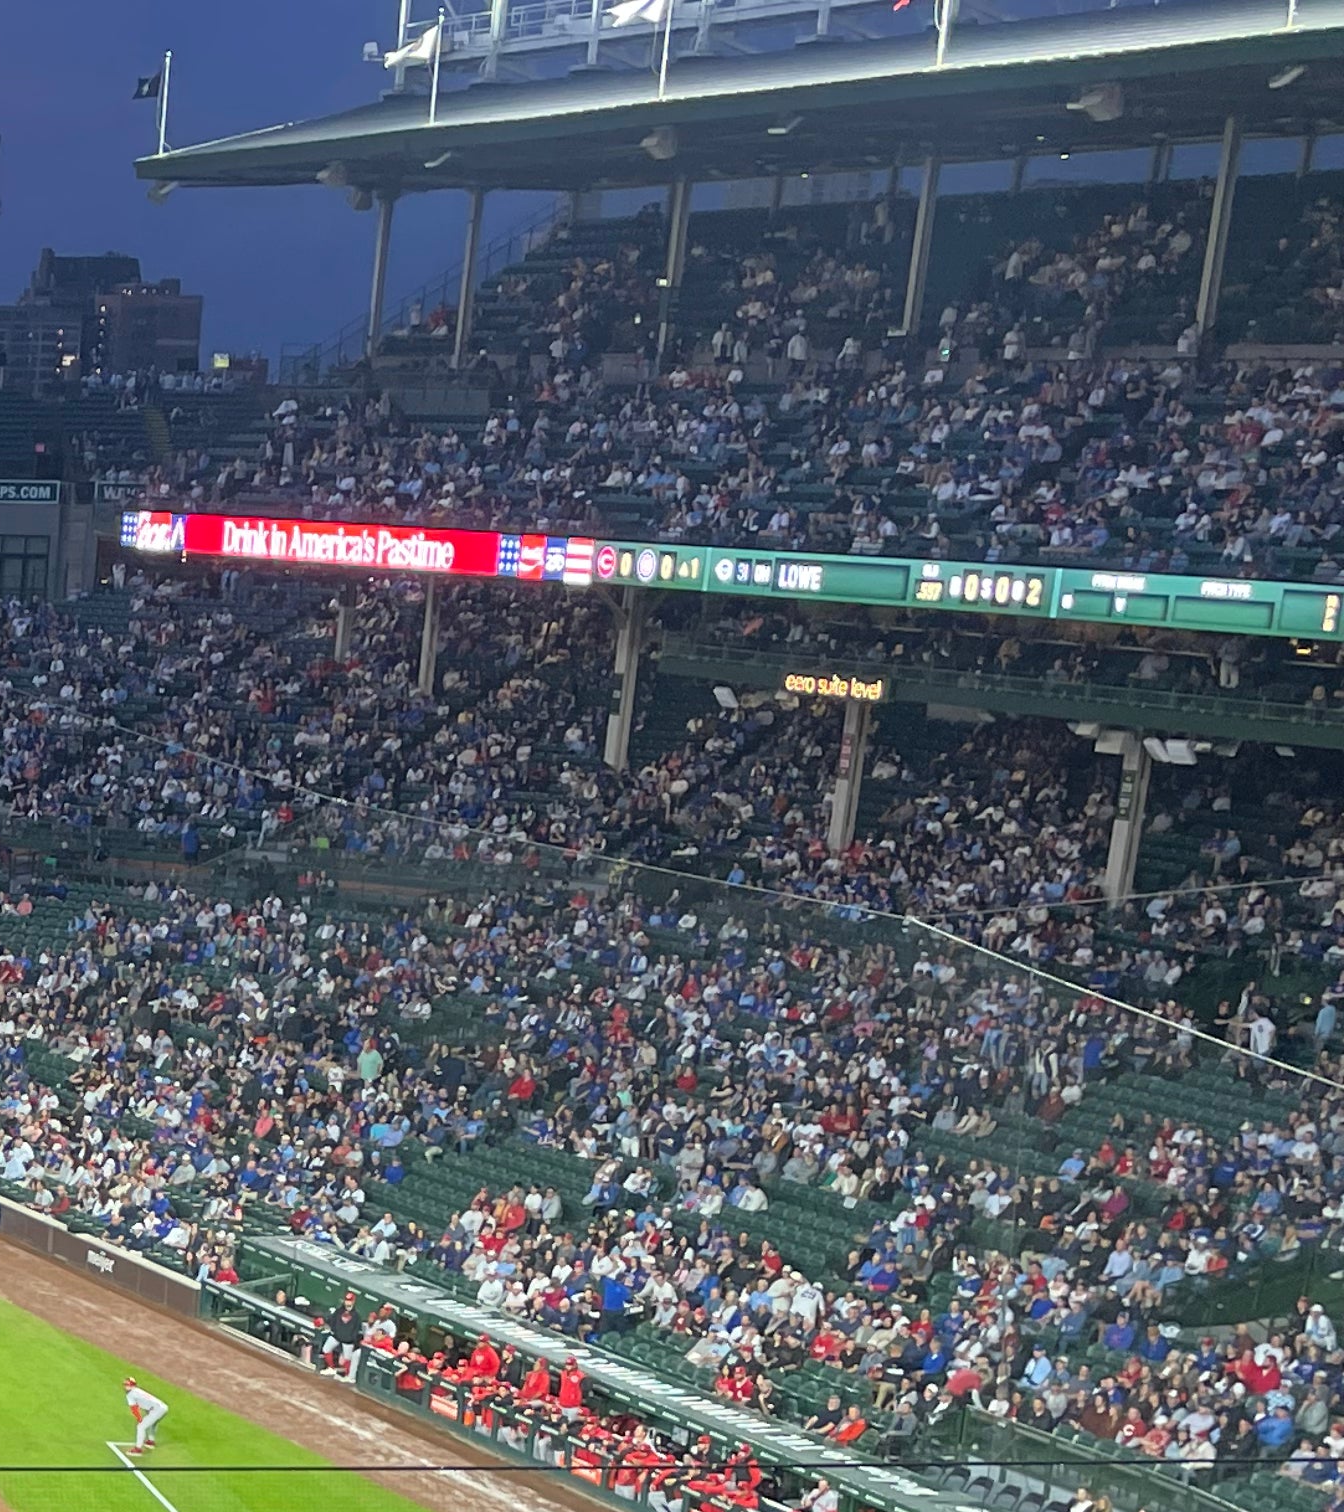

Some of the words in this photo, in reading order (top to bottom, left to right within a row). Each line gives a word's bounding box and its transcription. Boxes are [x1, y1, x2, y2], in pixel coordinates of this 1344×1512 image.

[223, 521, 268, 555] Drink
[270, 524, 286, 557] in
[289, 525, 374, 564] America's
[375, 529, 455, 569] Pastime
[779, 564, 823, 591] LOWE
[964, 574, 979, 601] 0
[995, 576, 1011, 604] 0
[1026, 579, 1042, 606] 2
[850, 677, 882, 700] level
